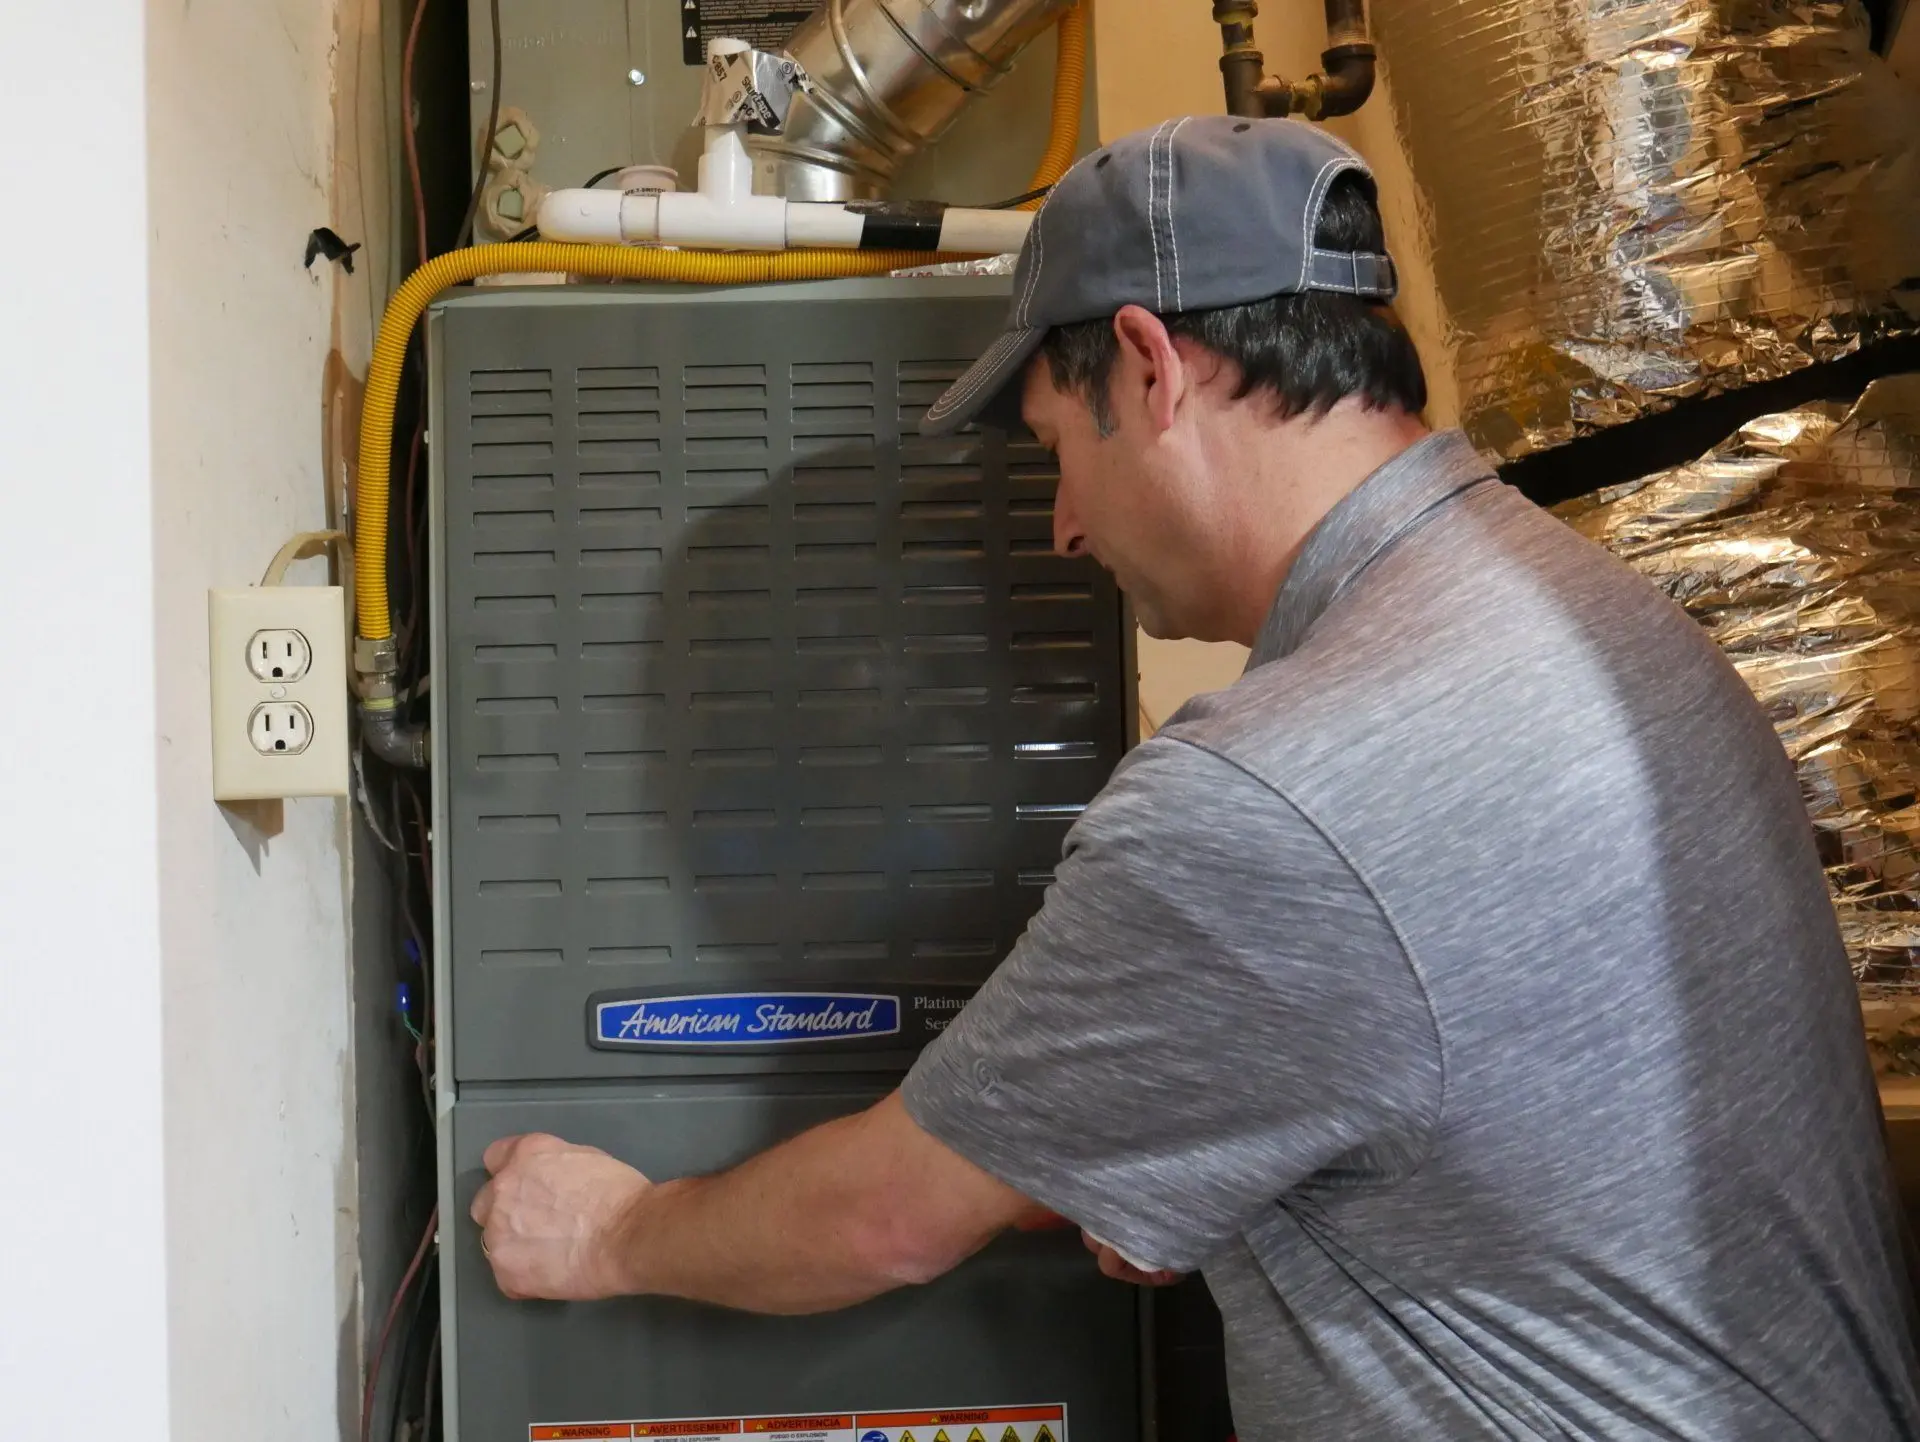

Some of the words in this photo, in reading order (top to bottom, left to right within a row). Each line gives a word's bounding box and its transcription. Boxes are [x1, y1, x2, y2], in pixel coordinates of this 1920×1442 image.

[913, 995, 969, 1010] Platinu
[619, 1004, 740, 1038] American
[747, 1001, 877, 1033] Standard
[940, 1411, 989, 1422] WARNING
[649, 1421, 736, 1433] AVERTISSEMENT
[767, 1418, 841, 1429] ADVERTENCIA
[560, 1426, 611, 1437] WARNING
